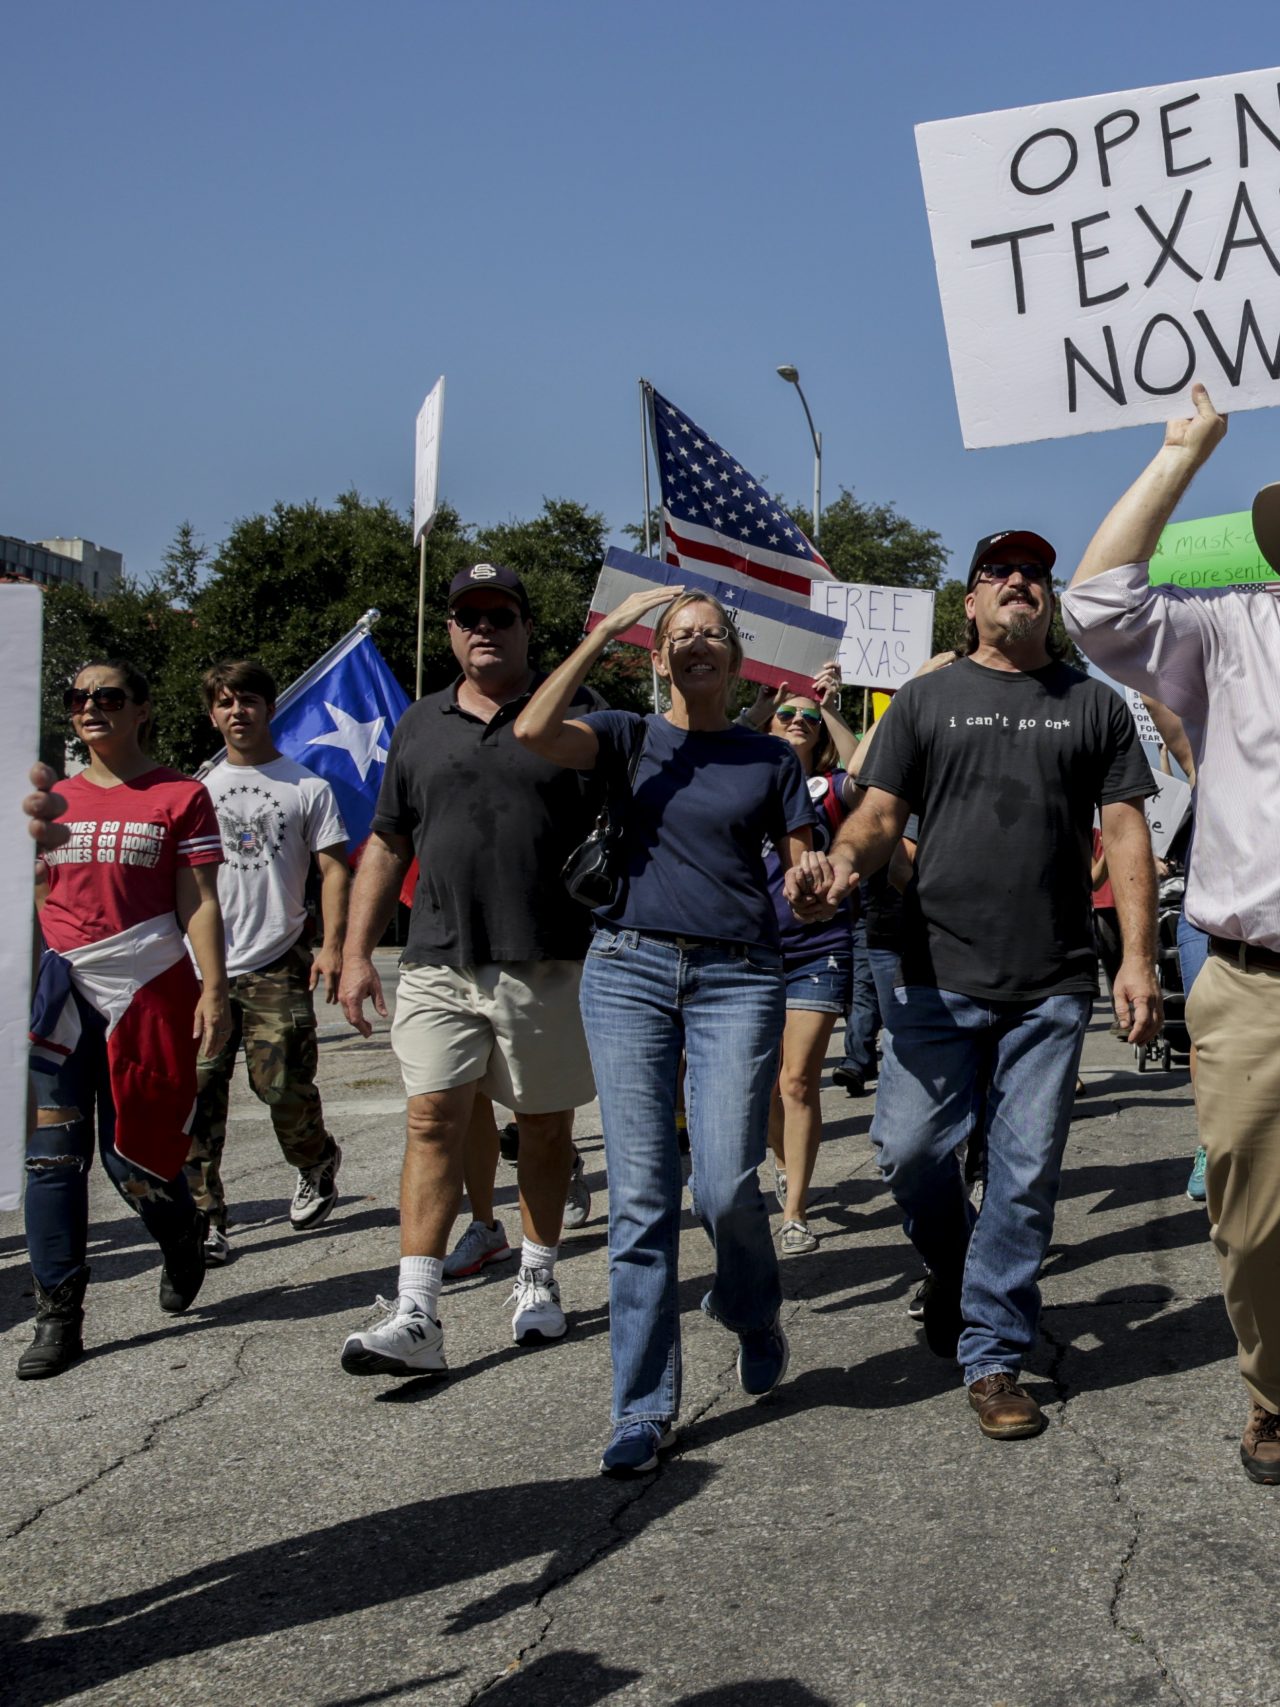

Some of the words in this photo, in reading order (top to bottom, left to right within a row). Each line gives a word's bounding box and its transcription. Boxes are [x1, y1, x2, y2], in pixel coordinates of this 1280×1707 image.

[826, 586, 913, 633] FREE
[838, 636, 911, 678] EXAS
[949, 716, 957, 728] i
[966, 713, 1009, 727] can't
[1018, 719, 1037, 731] go
[101, 821, 120, 834] GO
[124, 822, 166, 840] HOME!
[97, 834, 117, 848] GO
[121, 835, 162, 855] HOME!
[96, 849, 116, 864] GO
[119, 849, 160, 869] HOME!
[407, 1324, 426, 1343] N
